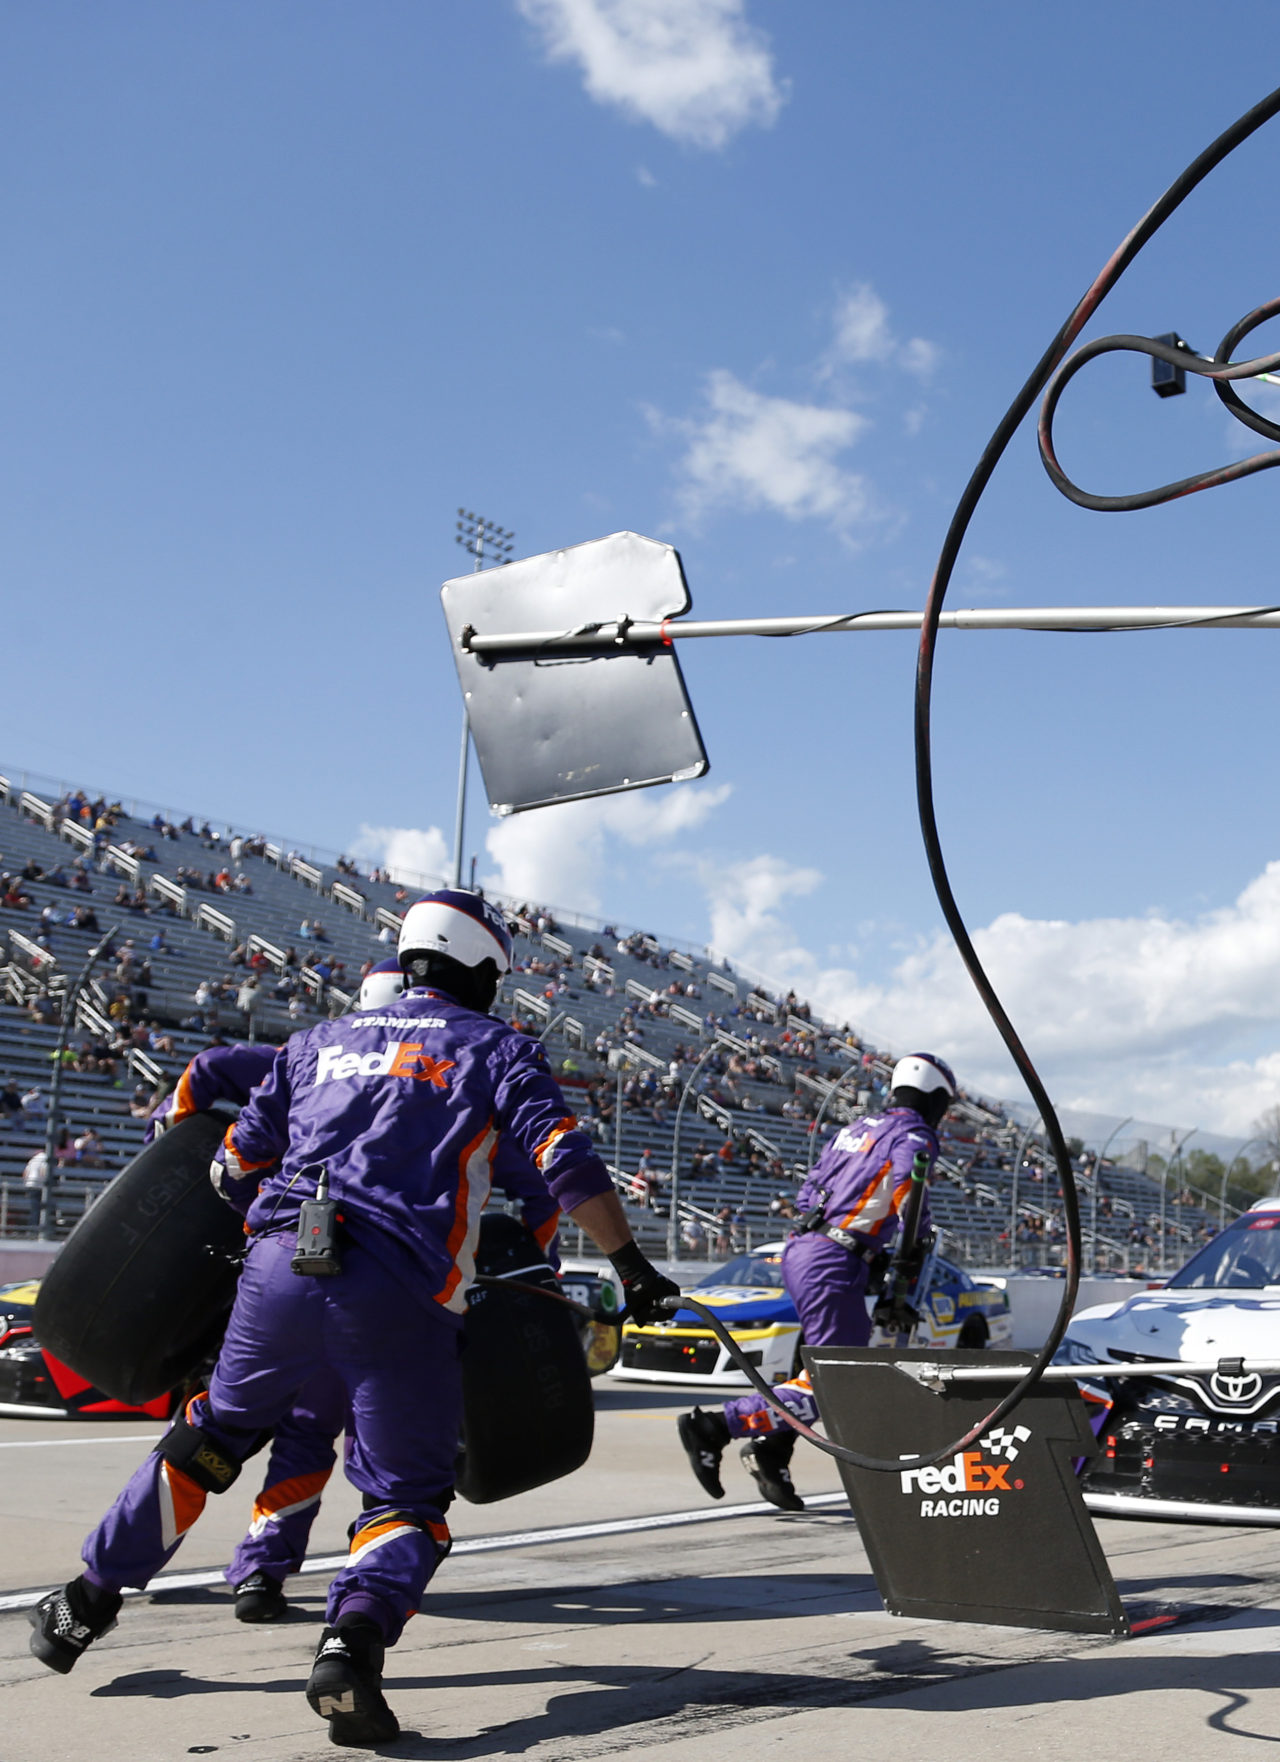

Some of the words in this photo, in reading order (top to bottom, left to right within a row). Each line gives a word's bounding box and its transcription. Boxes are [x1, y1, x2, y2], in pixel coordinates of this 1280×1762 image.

[351, 1016, 447, 1029] STAMPER
[313, 1041, 456, 1088] FedEx
[899, 1451, 1012, 1494] FedEx
[921, 1498, 1000, 1517] RACING
